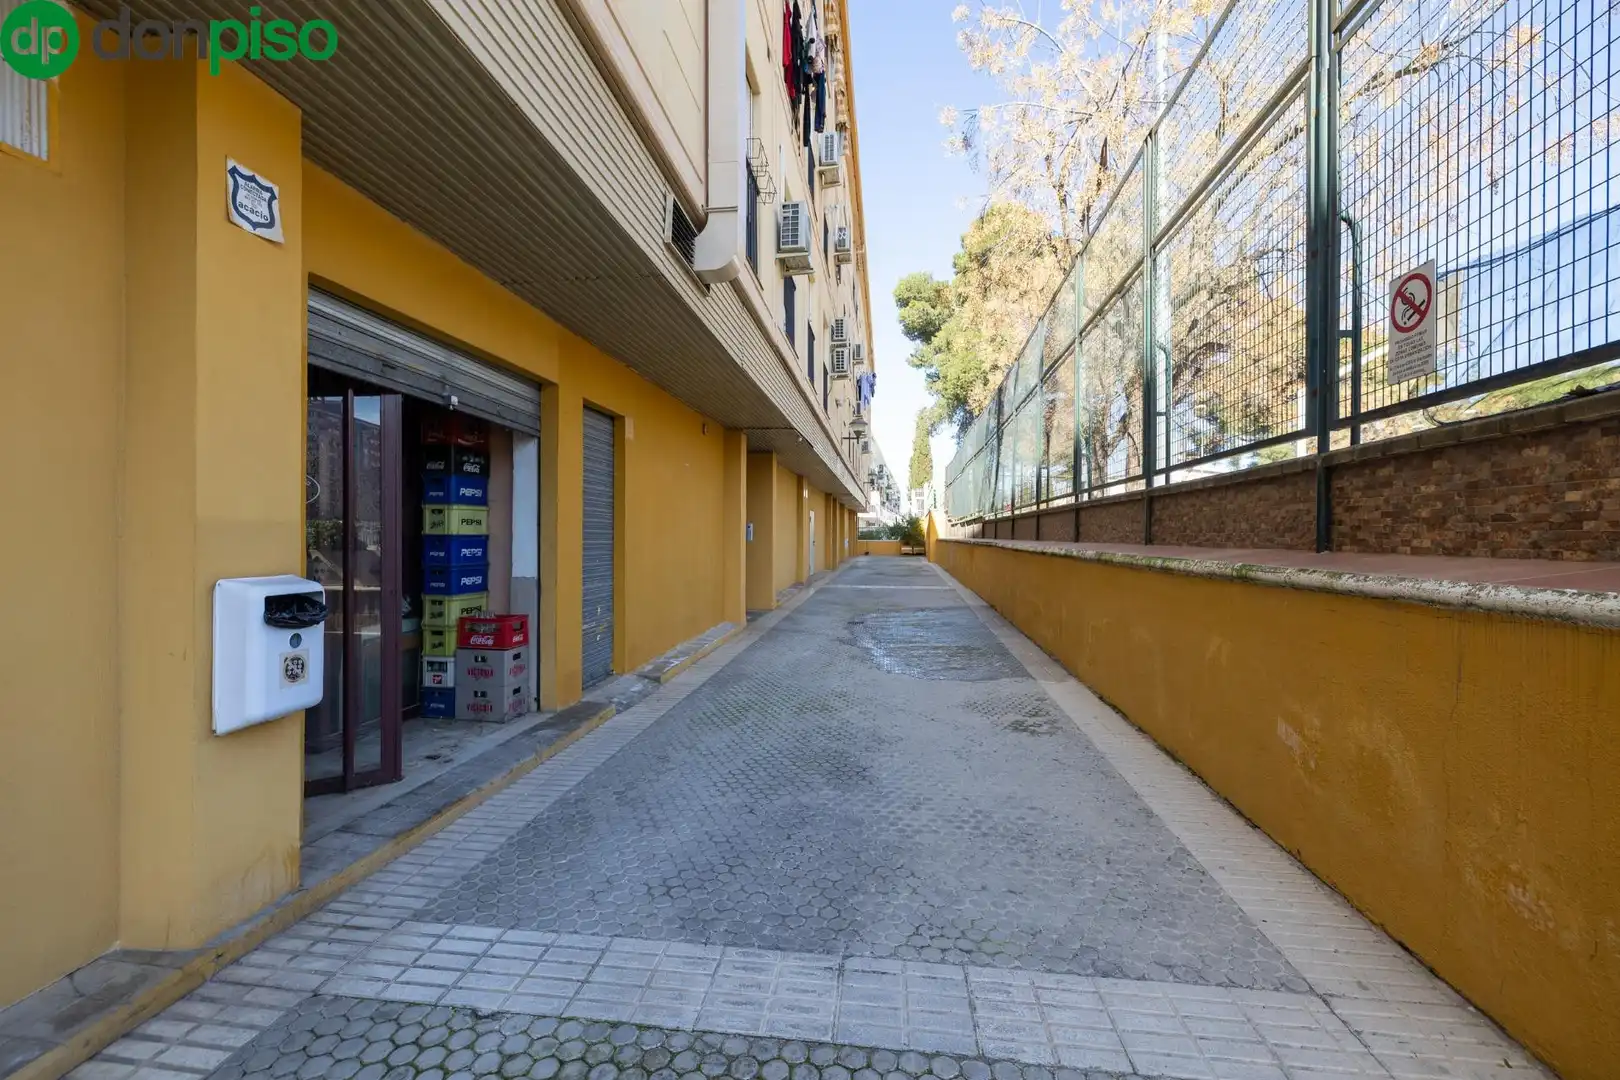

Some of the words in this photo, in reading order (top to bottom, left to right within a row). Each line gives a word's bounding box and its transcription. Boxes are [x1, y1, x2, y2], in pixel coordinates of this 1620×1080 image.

[238, 201, 269, 221] acacio
[459, 487, 483, 498] PEPSI
[460, 518, 482, 526] PEPSI
[460, 548, 483, 557] PEPSI
[460, 575, 483, 586] PEPSI
[460, 605, 482, 615] PEPSI
